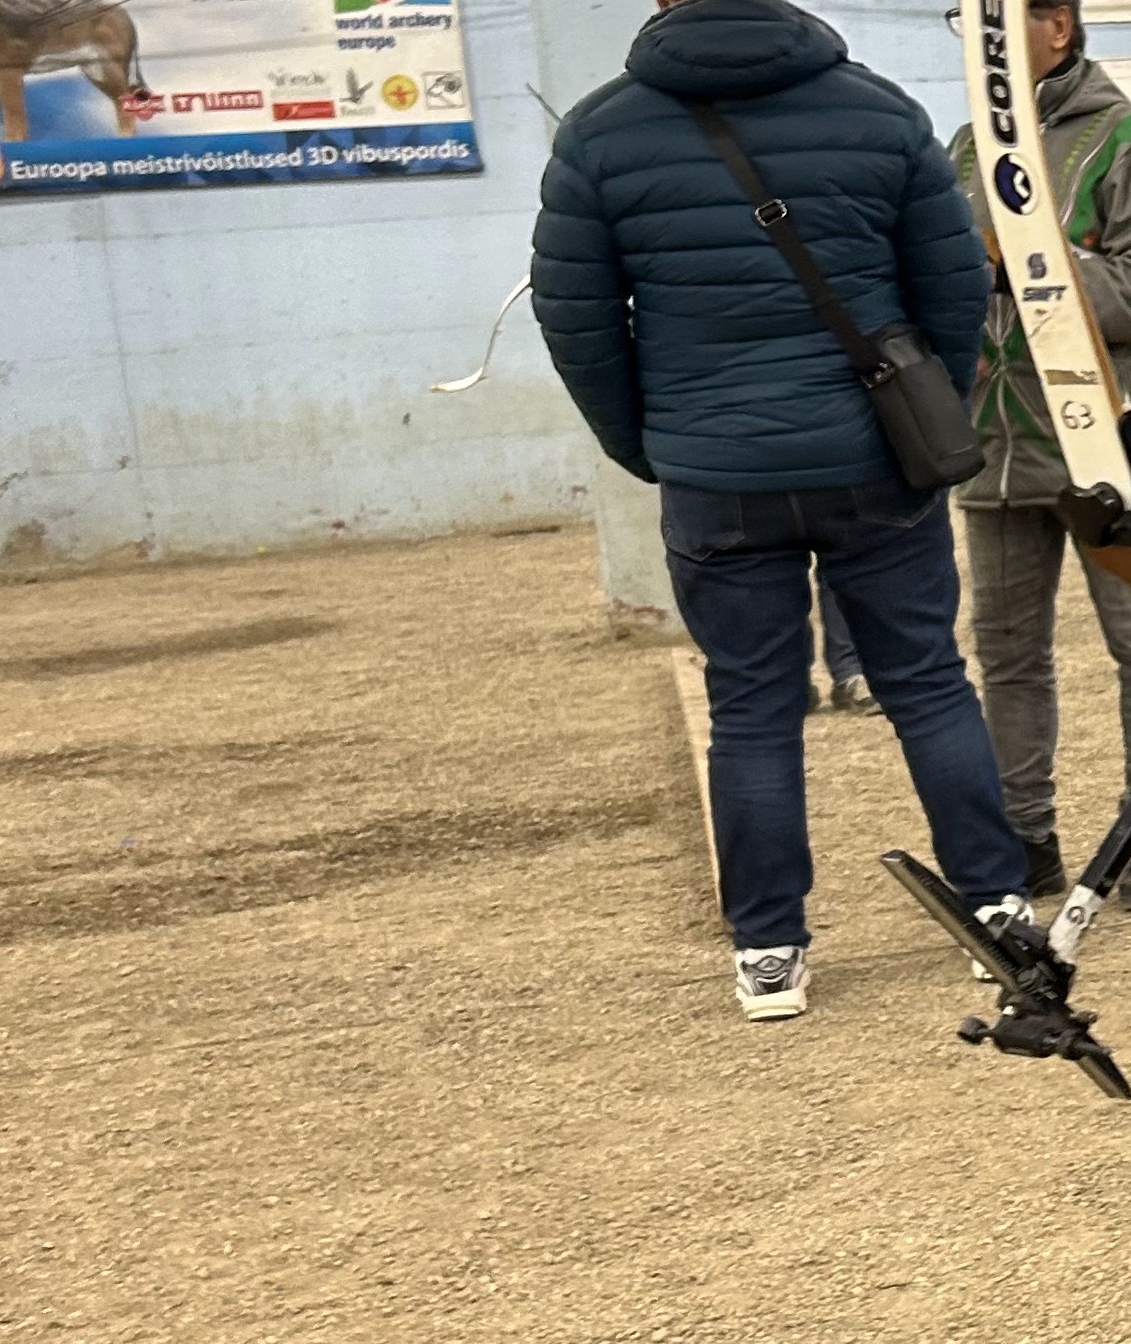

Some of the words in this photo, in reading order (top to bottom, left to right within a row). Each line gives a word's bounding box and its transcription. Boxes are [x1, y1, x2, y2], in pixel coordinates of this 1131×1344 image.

[335, 13, 383, 30] world
[388, 12, 452, 30] archery
[337, 36, 396, 53] europe
[10, 159, 108, 182] Euroopa
[306, 145, 339, 167] 3D
[342, 139, 470, 166] vibuspordis
[1061, 401, 1096, 430] 63
